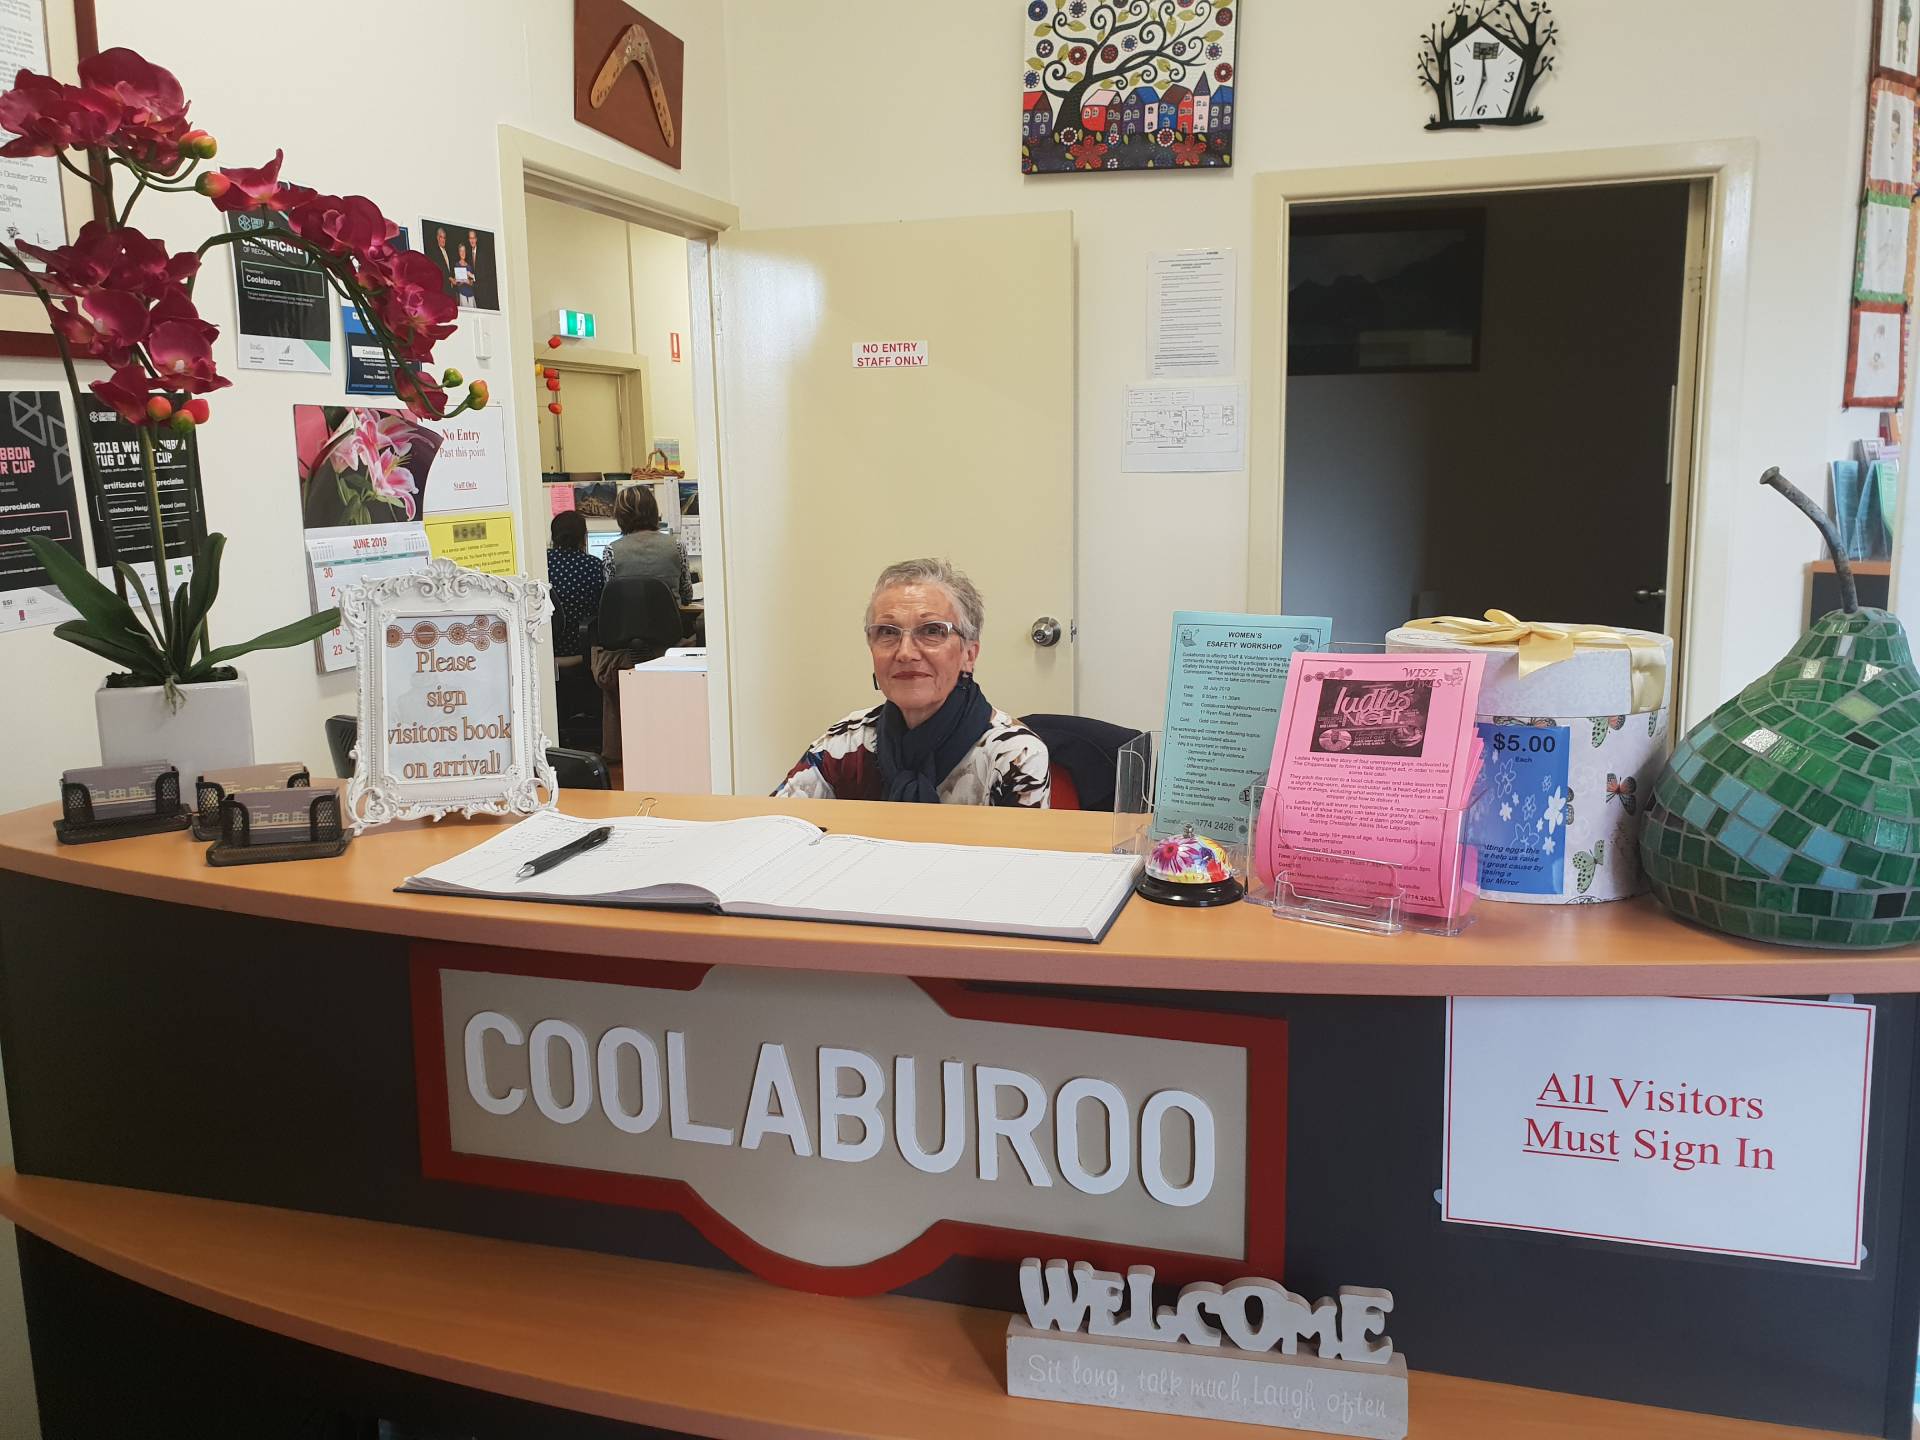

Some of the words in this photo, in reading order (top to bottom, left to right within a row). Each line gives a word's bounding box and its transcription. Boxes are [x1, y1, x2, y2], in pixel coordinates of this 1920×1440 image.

[1454, 74, 1465, 86] 9
[1504, 72, 1515, 83] 3
[1476, 104, 1488, 117] 6
[862, 344, 878, 354] NO
[882, 342, 918, 352] ENTRY
[857, 356, 892, 366] STAFF
[894, 355, 924, 366] ONLY
[442, 428, 454, 440] No
[457, 428, 480, 444] Entry
[156, 452, 173, 464] CUP
[440, 447, 454, 458] Past
[456, 446, 468, 457] this
[468, 446, 486, 460] point
[12, 460, 36, 474] CUP
[352, 538, 371, 550] JUNE
[370, 536, 388, 548] 2019
[323, 568, 334, 578] 30
[330, 586, 336, 597] 2
[1228, 631, 1263, 639] WOMEN'S
[332, 644, 343, 656] 23
[1206, 640, 1238, 648] ESAFETY
[1240, 642, 1282, 650] WORKSHOP
[416, 648, 477, 674] Please
[1402, 668, 1440, 678] WISE
[427, 685, 468, 714] sign
[388, 722, 458, 745] visitors
[462, 715, 512, 742] book
[1493, 732, 1556, 753] $5.00
[402, 761, 430, 779] on
[433, 750, 502, 778] arrival!
[1197, 820, 1212, 828] 774
[1215, 822, 1234, 832] 2426
[1490, 853, 1508, 861] help
[1534, 865, 1544, 873] by
[1496, 878, 1520, 886] Mirror
[1536, 1072, 1597, 1107] All
[1610, 1077, 1765, 1120] Visitors
[463, 1010, 1217, 1207] COOLABUROO
[1523, 1117, 1620, 1157] Must
[1633, 1128, 1722, 1171] Sign
[1735, 1136, 1775, 1171] In
[1019, 1257, 1394, 1365] WELCOME
[1028, 1353, 1062, 1385] Sit
[1071, 1355, 1126, 1398] long,
[1136, 1367, 1183, 1397] talk
[1189, 1369, 1249, 1406] much,
[1252, 1377, 1317, 1418] Laugh
[1326, 1389, 1388, 1424] often
